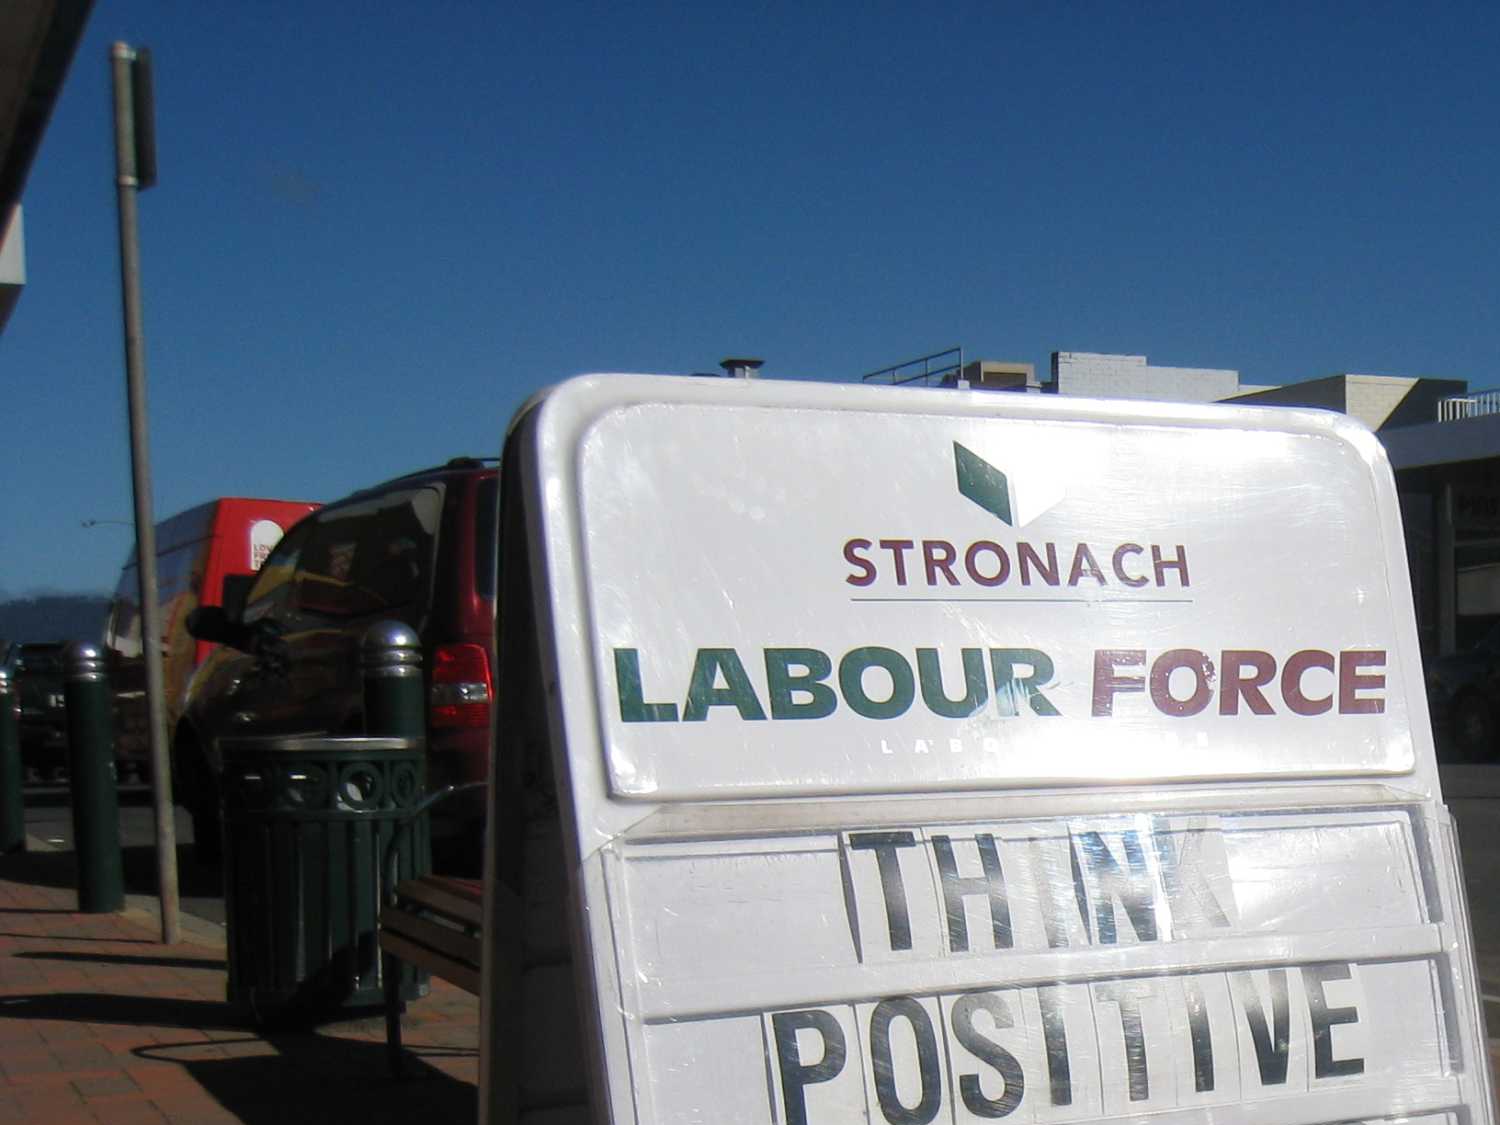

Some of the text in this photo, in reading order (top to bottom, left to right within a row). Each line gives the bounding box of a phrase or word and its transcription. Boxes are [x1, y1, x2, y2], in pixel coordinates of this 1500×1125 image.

[844, 537, 1191, 588] STRONACH
[613, 647, 1387, 723] LABOUR FORCE
[850, 820, 1231, 952] THINK
